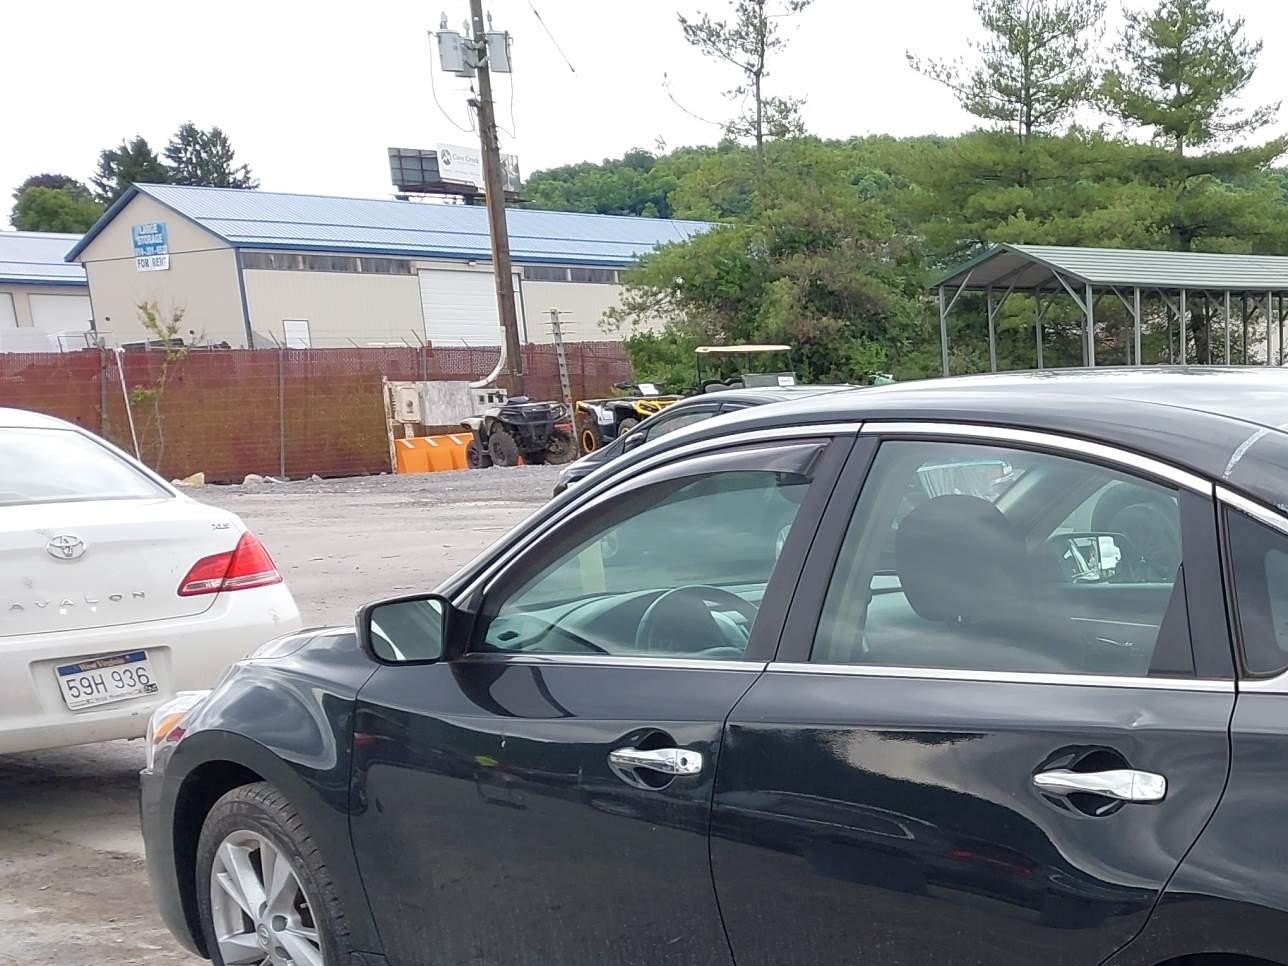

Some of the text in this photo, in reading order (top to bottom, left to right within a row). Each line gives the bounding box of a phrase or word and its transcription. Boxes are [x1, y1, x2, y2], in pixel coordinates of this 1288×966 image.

[137, 233, 163, 245] STORAGE
[137, 256, 167, 268] FOR RENT
[8, 591, 146, 611] AVALON
[66, 674, 107, 698] 59H
[111, 666, 150, 689] 936
